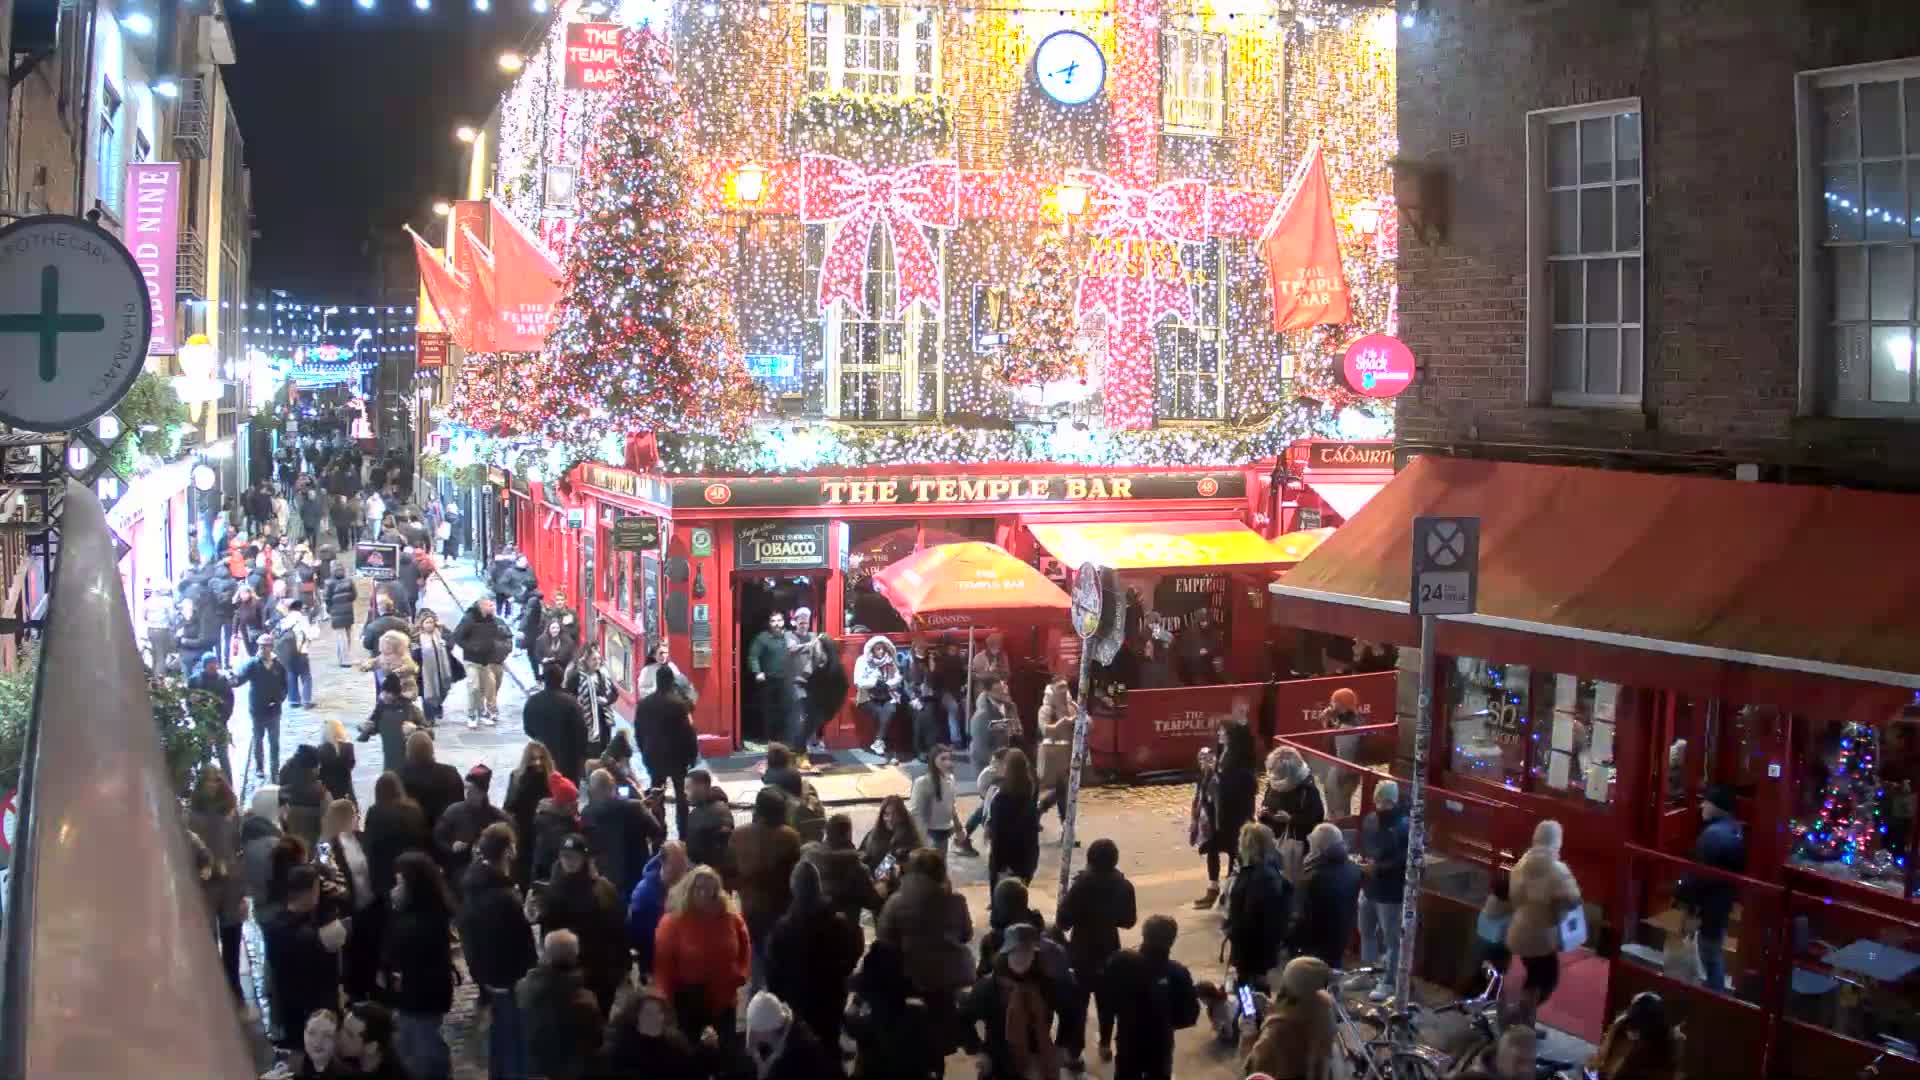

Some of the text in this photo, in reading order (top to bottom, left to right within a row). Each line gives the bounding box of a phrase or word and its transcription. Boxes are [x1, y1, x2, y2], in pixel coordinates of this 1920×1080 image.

[583, 28, 617, 45] THE
[567, 47, 622, 64] TEMPL
[137, 171, 170, 234] NINE
[2, 231, 112, 265] POTHECARY
[1280, 278, 1344, 295] TEMPLE
[519, 303, 545, 312] THE
[820, 476, 1133, 504] THE TEMPLE BAR
[751, 538, 816, 562] TOBACCO
[1422, 583, 1443, 603] 24
[1153, 719, 1208, 732] TEMPLE
